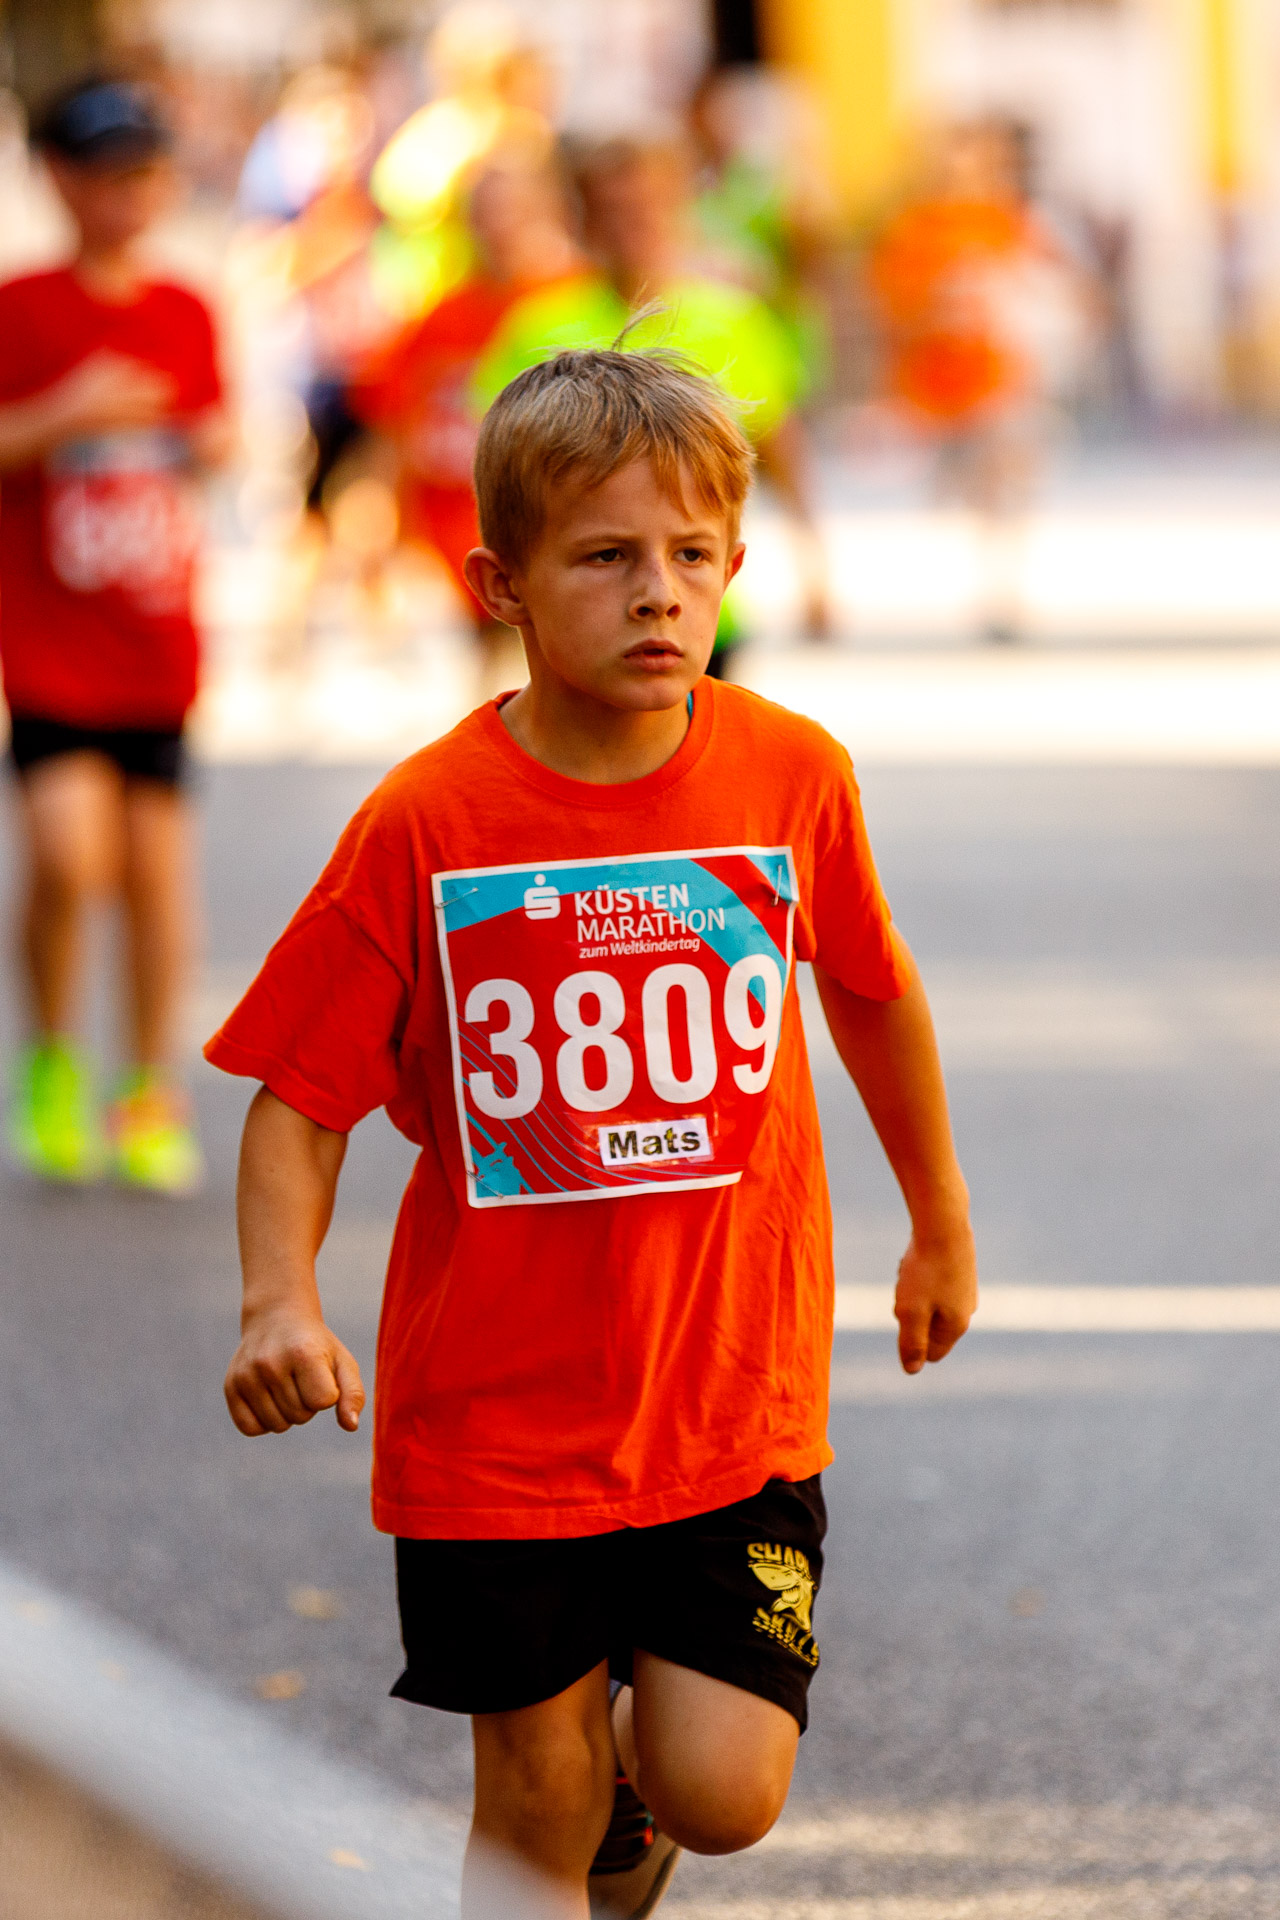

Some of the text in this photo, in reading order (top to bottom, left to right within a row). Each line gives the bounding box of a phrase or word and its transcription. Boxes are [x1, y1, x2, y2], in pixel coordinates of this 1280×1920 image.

[574, 883, 690, 917] KÜSTEN
[577, 907, 726, 943] MARATHON
[578, 937, 701, 959] zum Weltkindertag
[464, 953, 782, 1120] 3809
[608, 1126, 701, 1159] Mats
